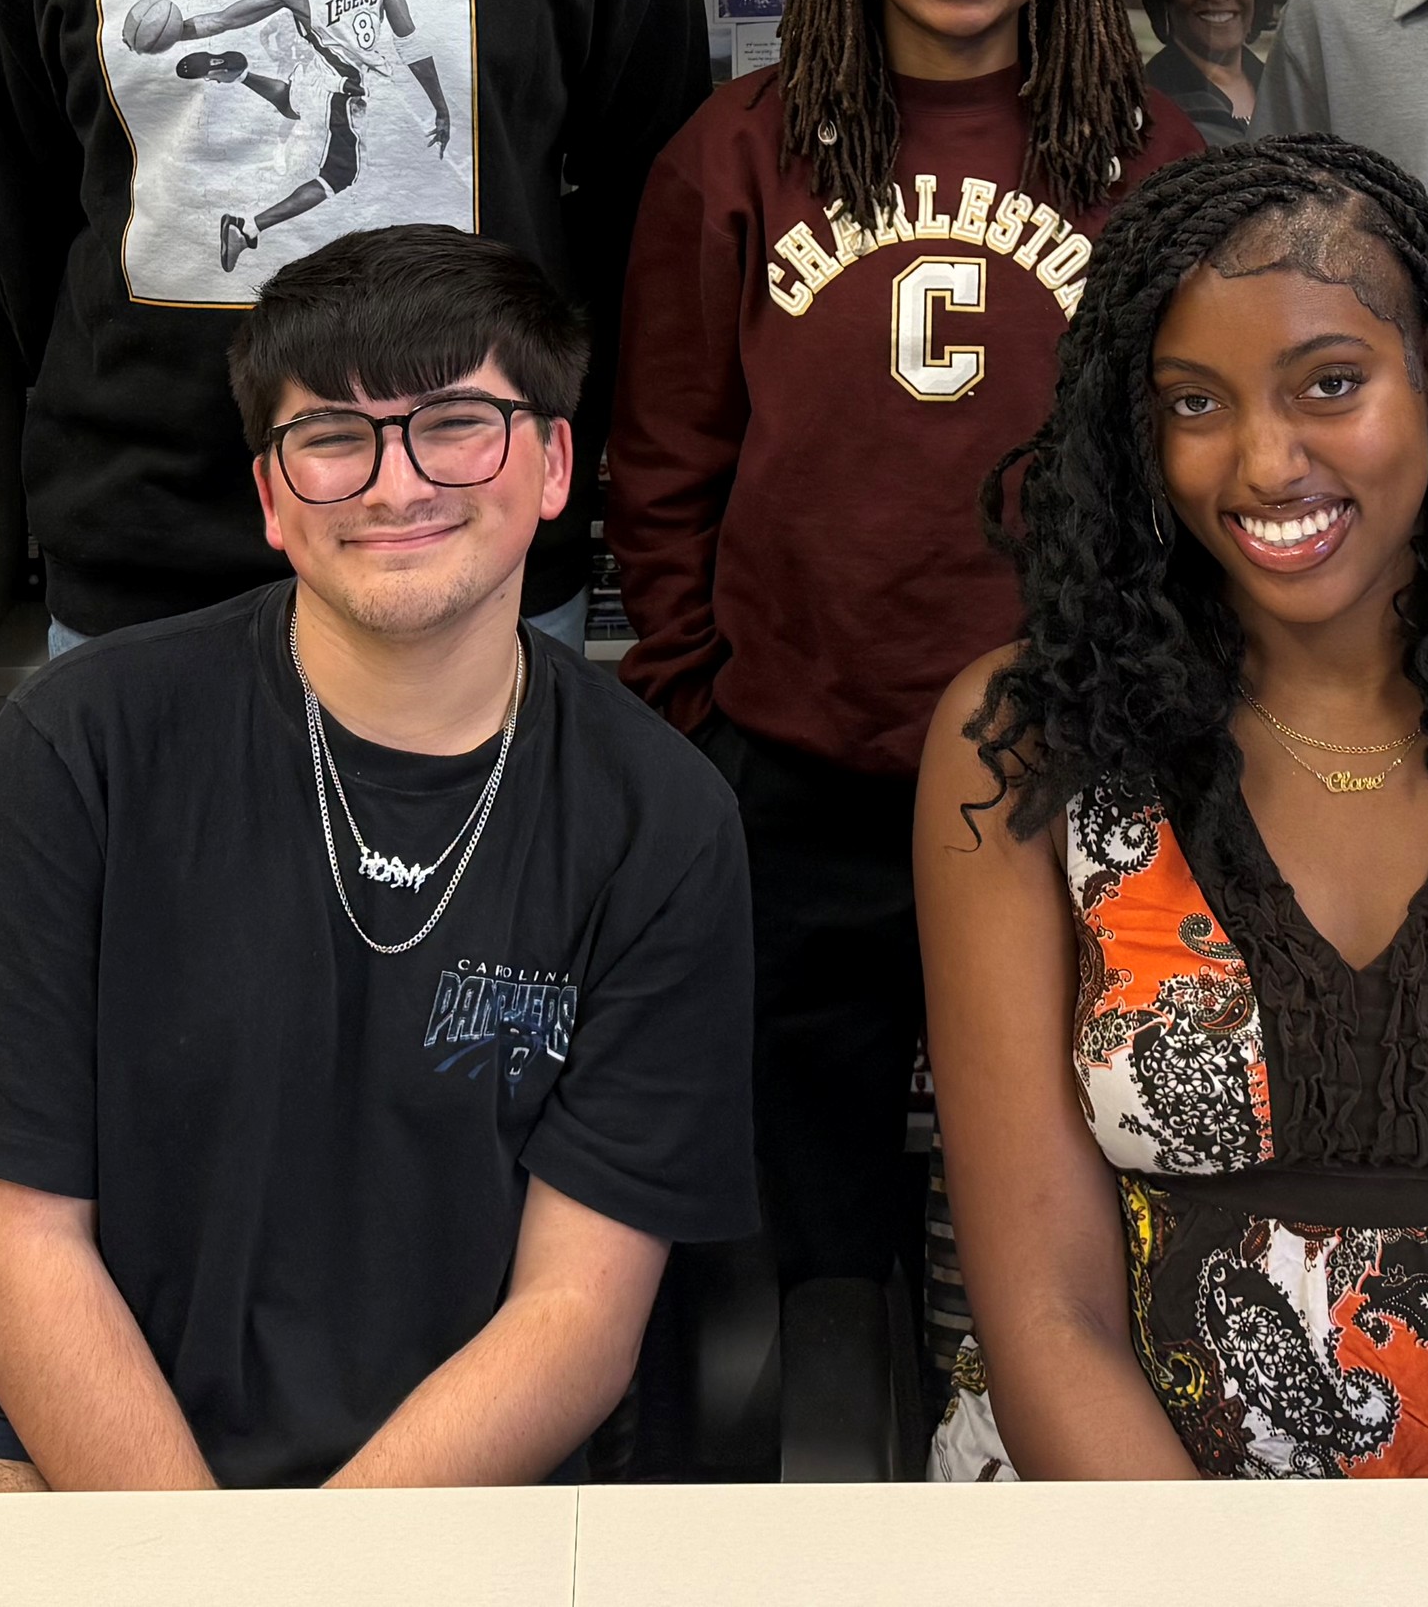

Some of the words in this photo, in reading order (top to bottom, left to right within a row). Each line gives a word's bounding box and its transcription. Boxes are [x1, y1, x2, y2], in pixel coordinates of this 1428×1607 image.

[353, 12, 376, 51] 8
[890, 255, 986, 401] C
[458, 959, 570, 983] CAROLINA
